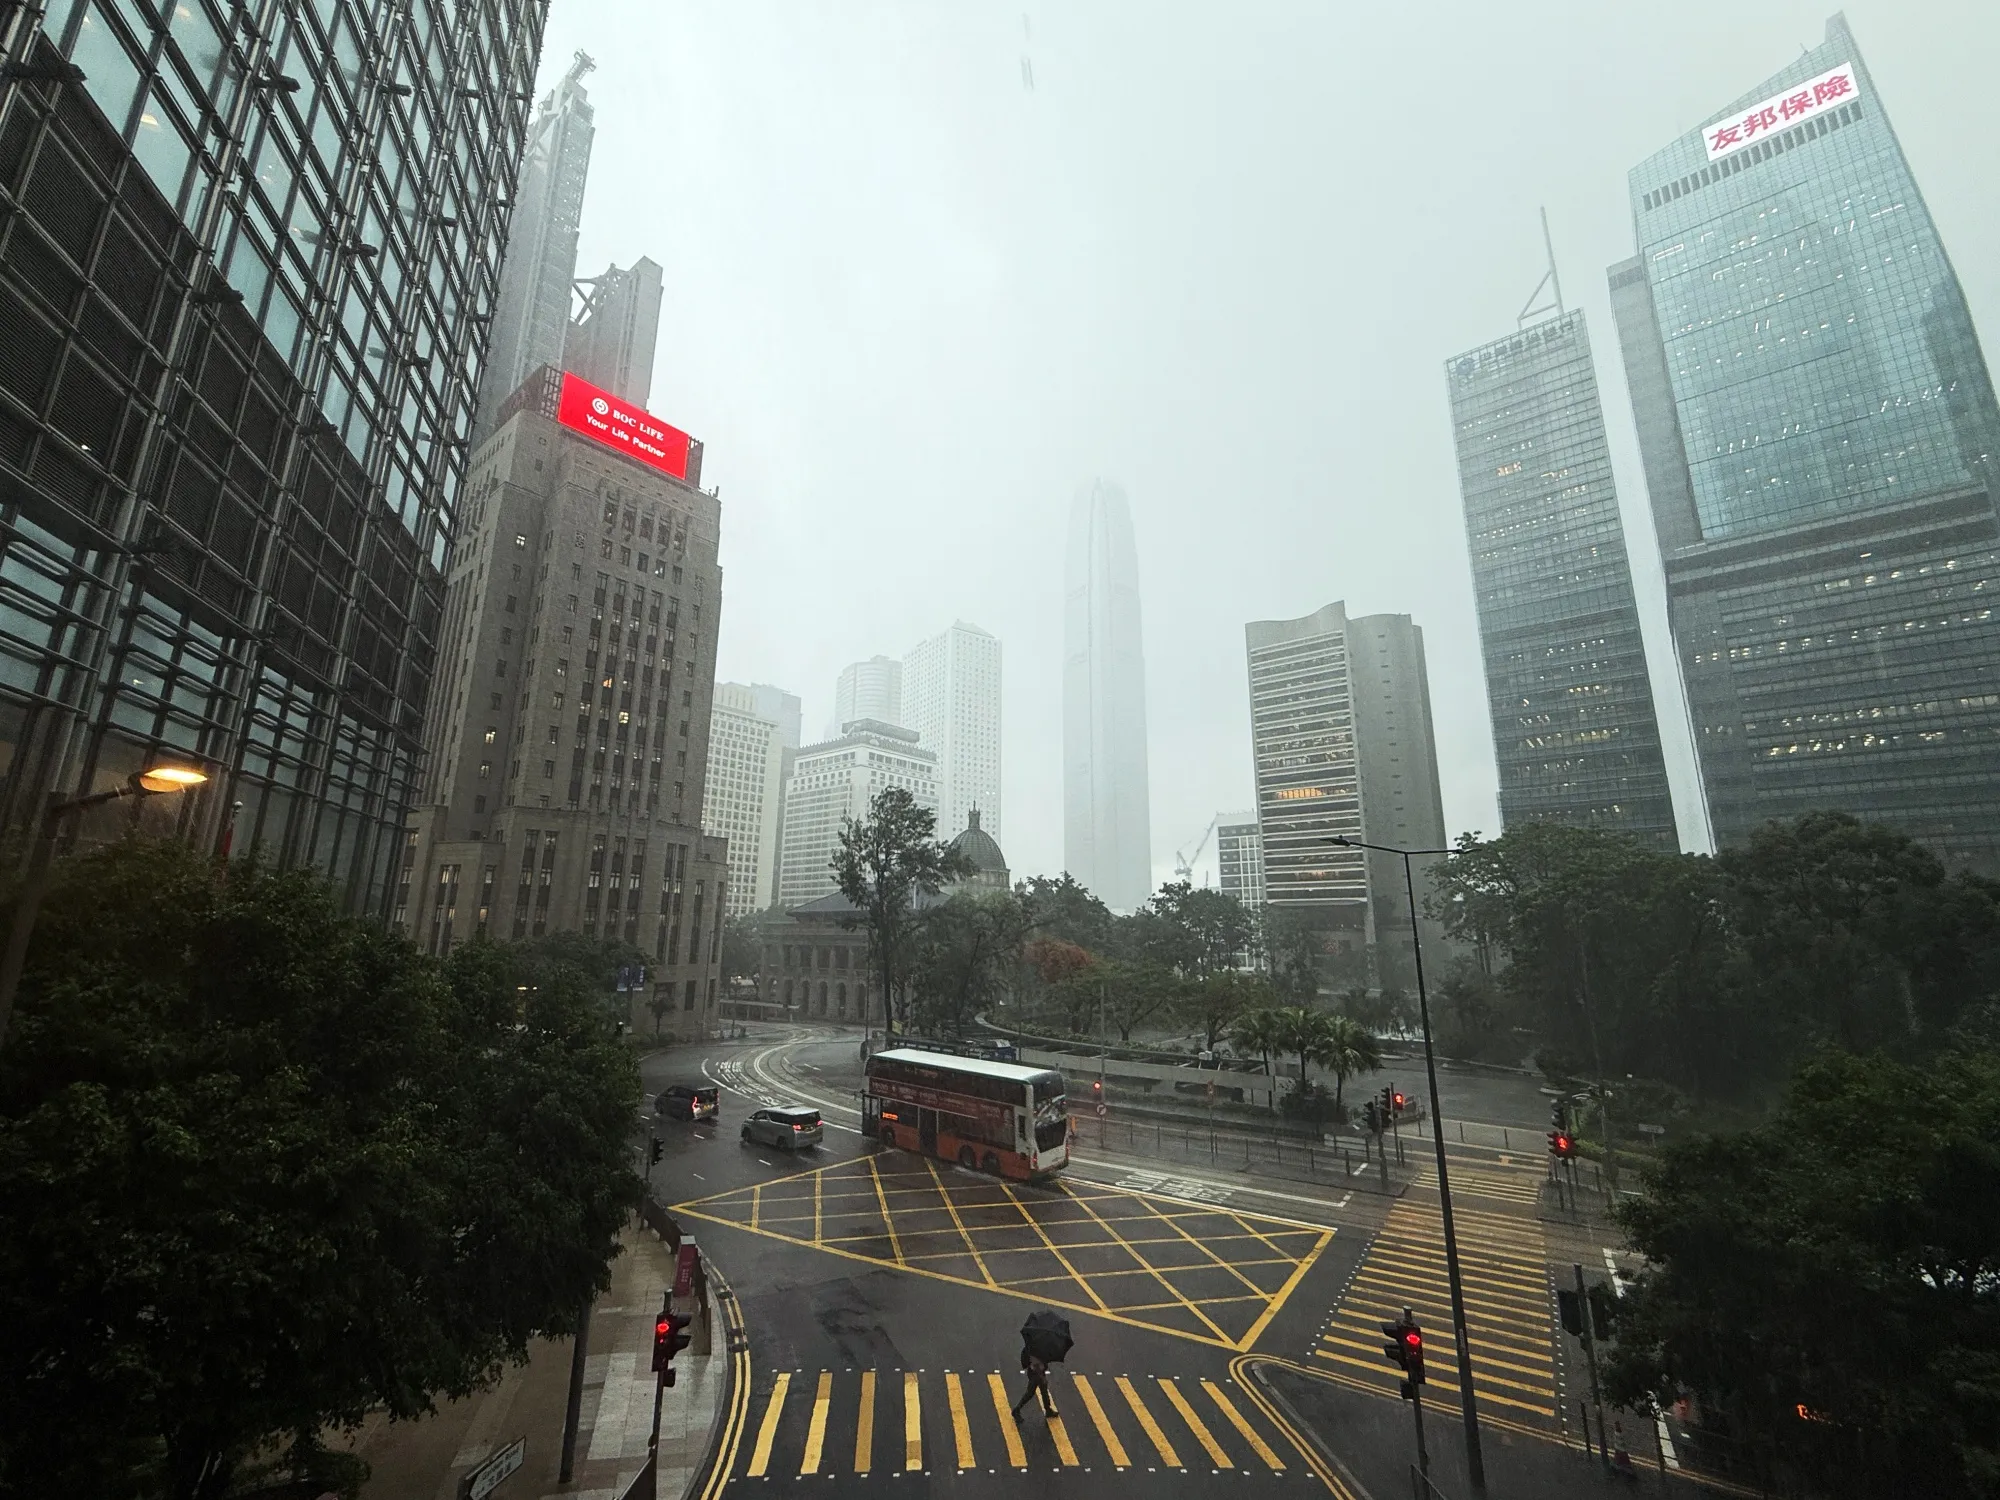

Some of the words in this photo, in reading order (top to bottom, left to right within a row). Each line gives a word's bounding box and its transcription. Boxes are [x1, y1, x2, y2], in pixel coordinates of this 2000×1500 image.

[1709, 74, 1852, 151] 友邦保險
[586, 413, 608, 431] Your
[612, 427, 629, 441] Life
[633, 436, 666, 458] Partner
[612, 409, 637, 427] BOC
[639, 422, 664, 441] LIFE
